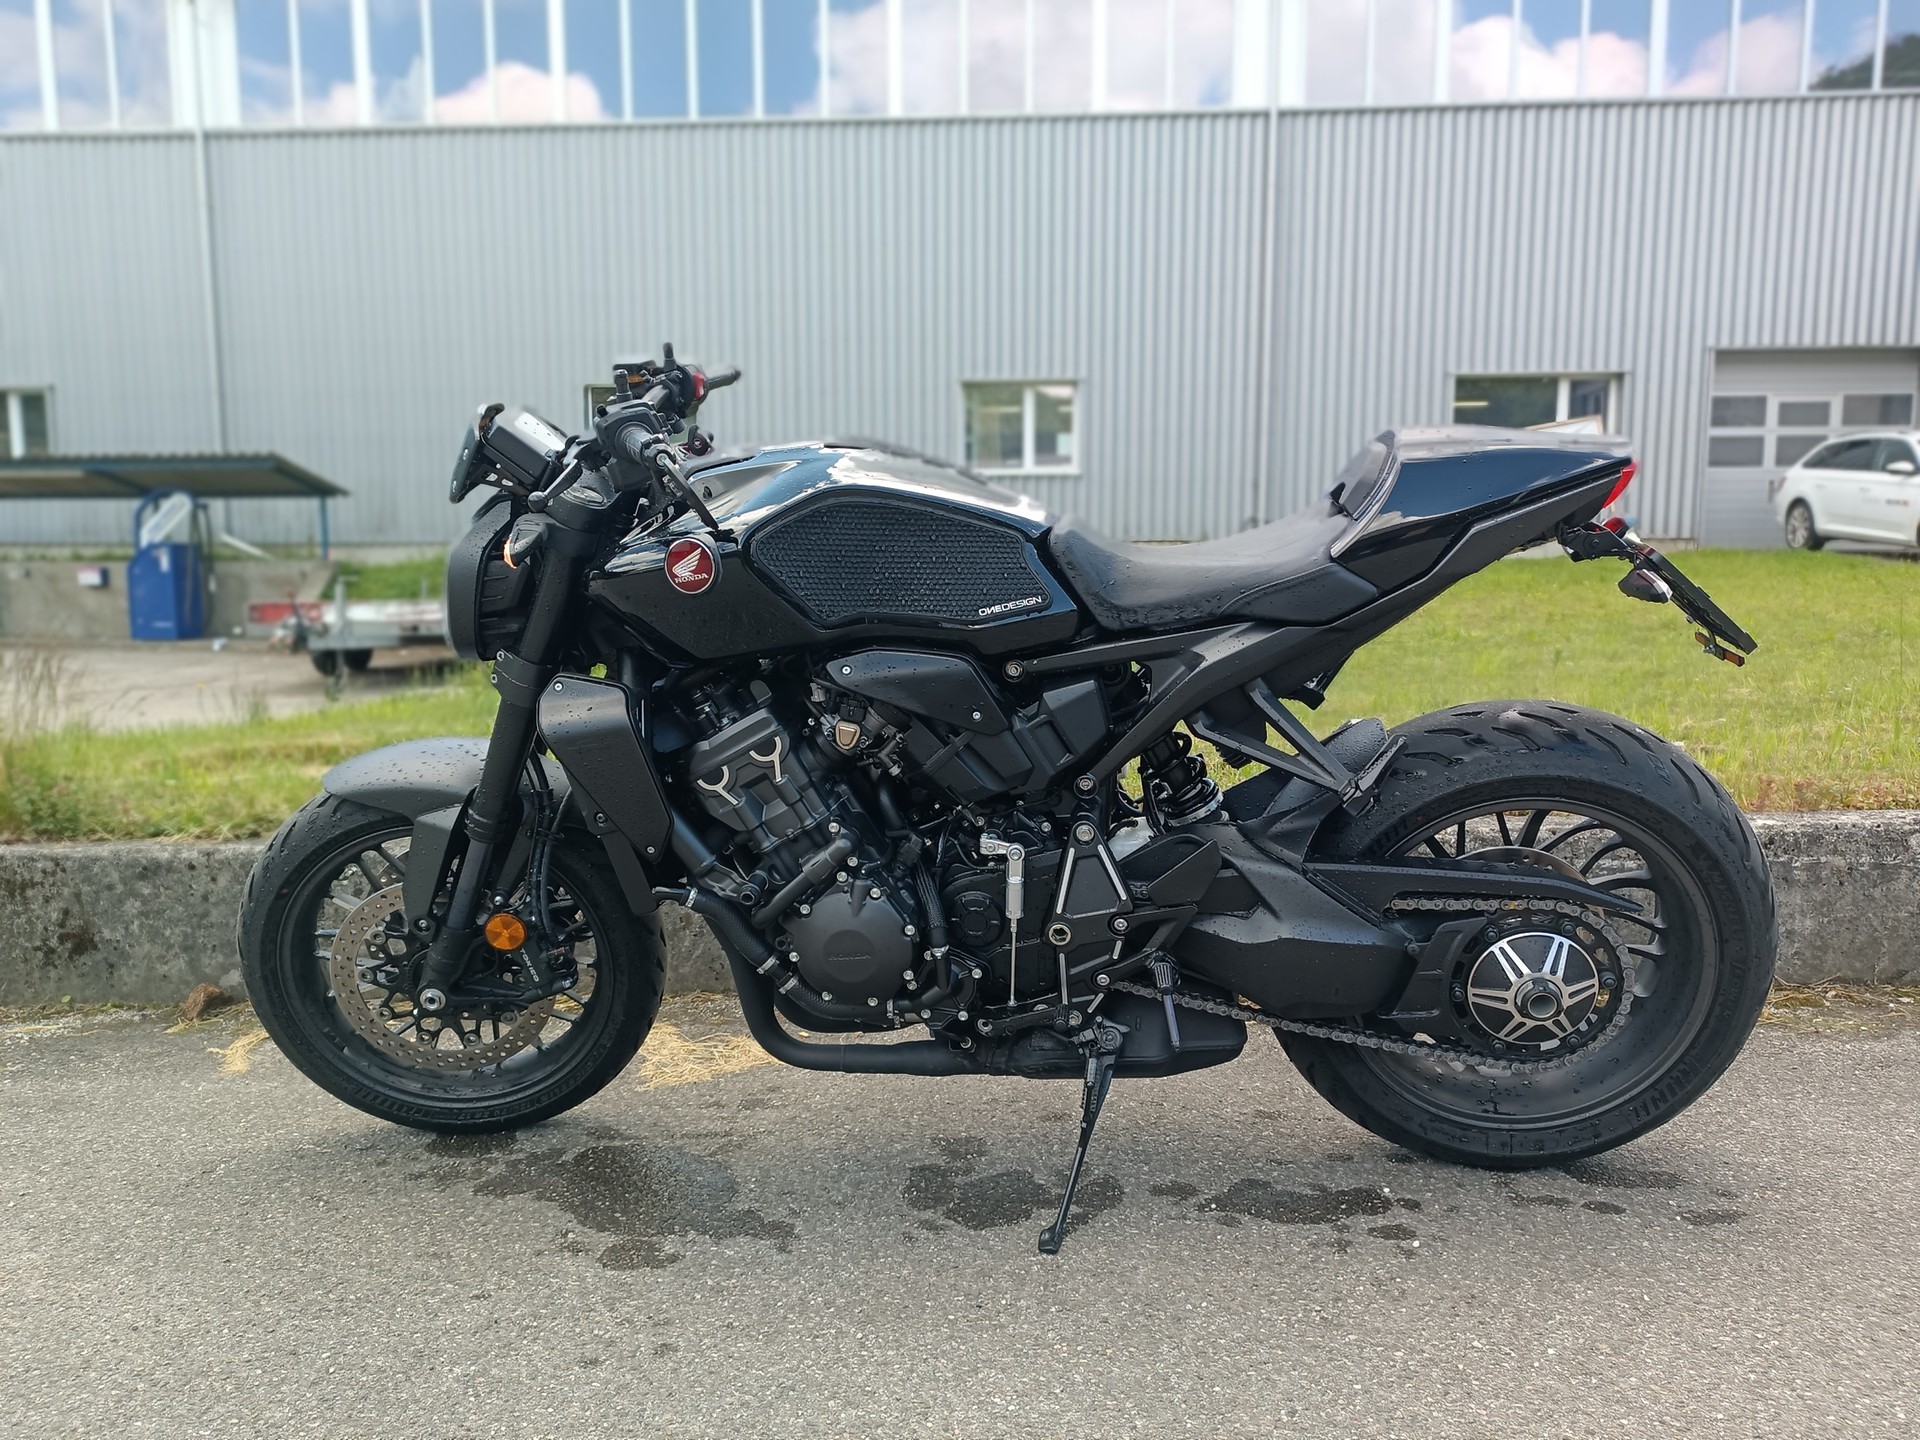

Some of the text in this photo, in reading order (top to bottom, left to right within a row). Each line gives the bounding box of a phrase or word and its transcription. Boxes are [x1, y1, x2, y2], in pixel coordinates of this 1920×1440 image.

[674, 573, 709, 584] HONDA
[978, 595, 1042, 616] ONEDESIGN
[519, 947, 540, 982] TOKICO
[826, 952, 872, 961] HONDA
